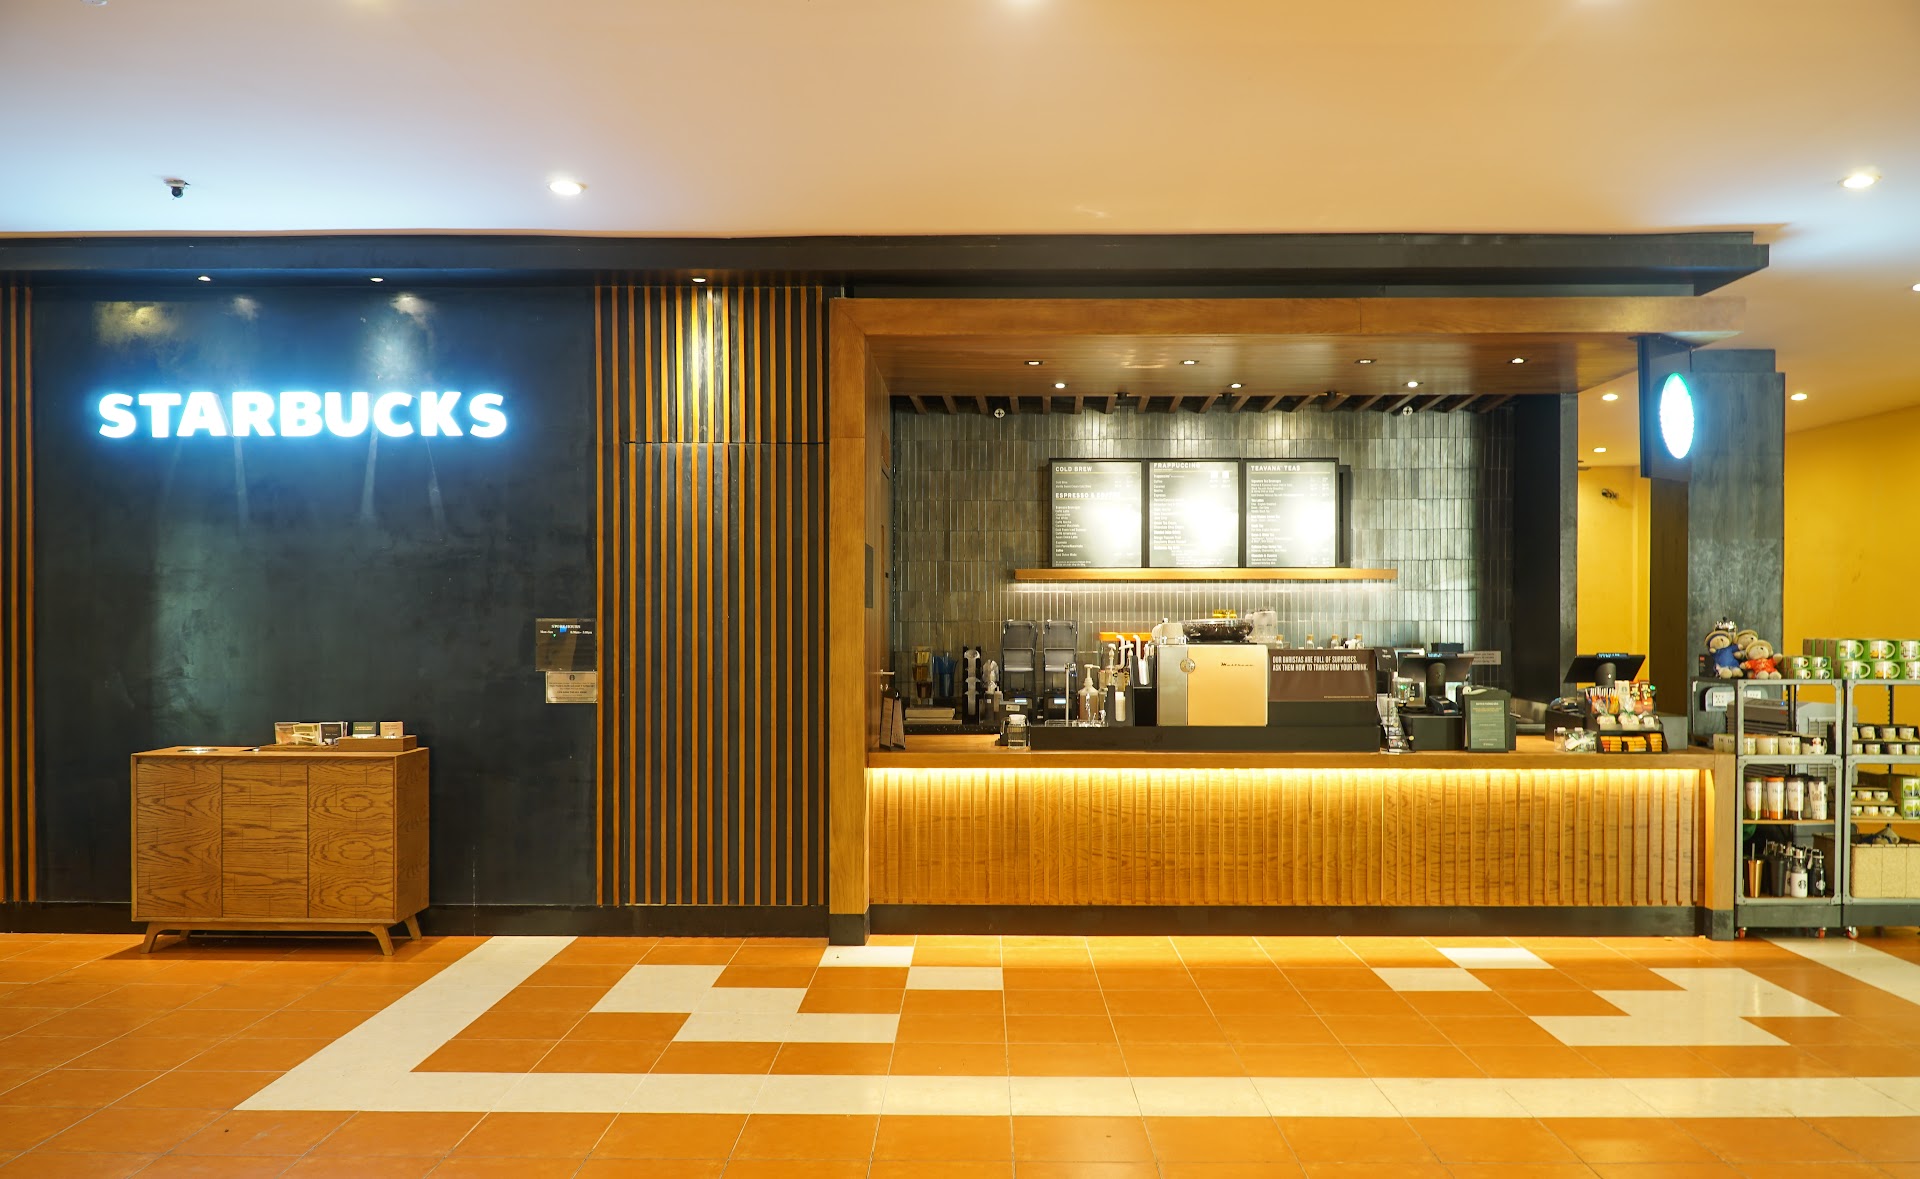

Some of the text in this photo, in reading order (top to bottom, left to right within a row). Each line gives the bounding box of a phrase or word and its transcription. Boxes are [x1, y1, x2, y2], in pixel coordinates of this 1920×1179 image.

[98, 391, 507, 438] STARBUCKS
[1272, 656, 1358, 664] OUR BARISTAS ARE FULL OF SURPRISES.
[1272, 664, 1369, 672] ASK THEM HOW TO TRANSFORM YOUR DRINK.
